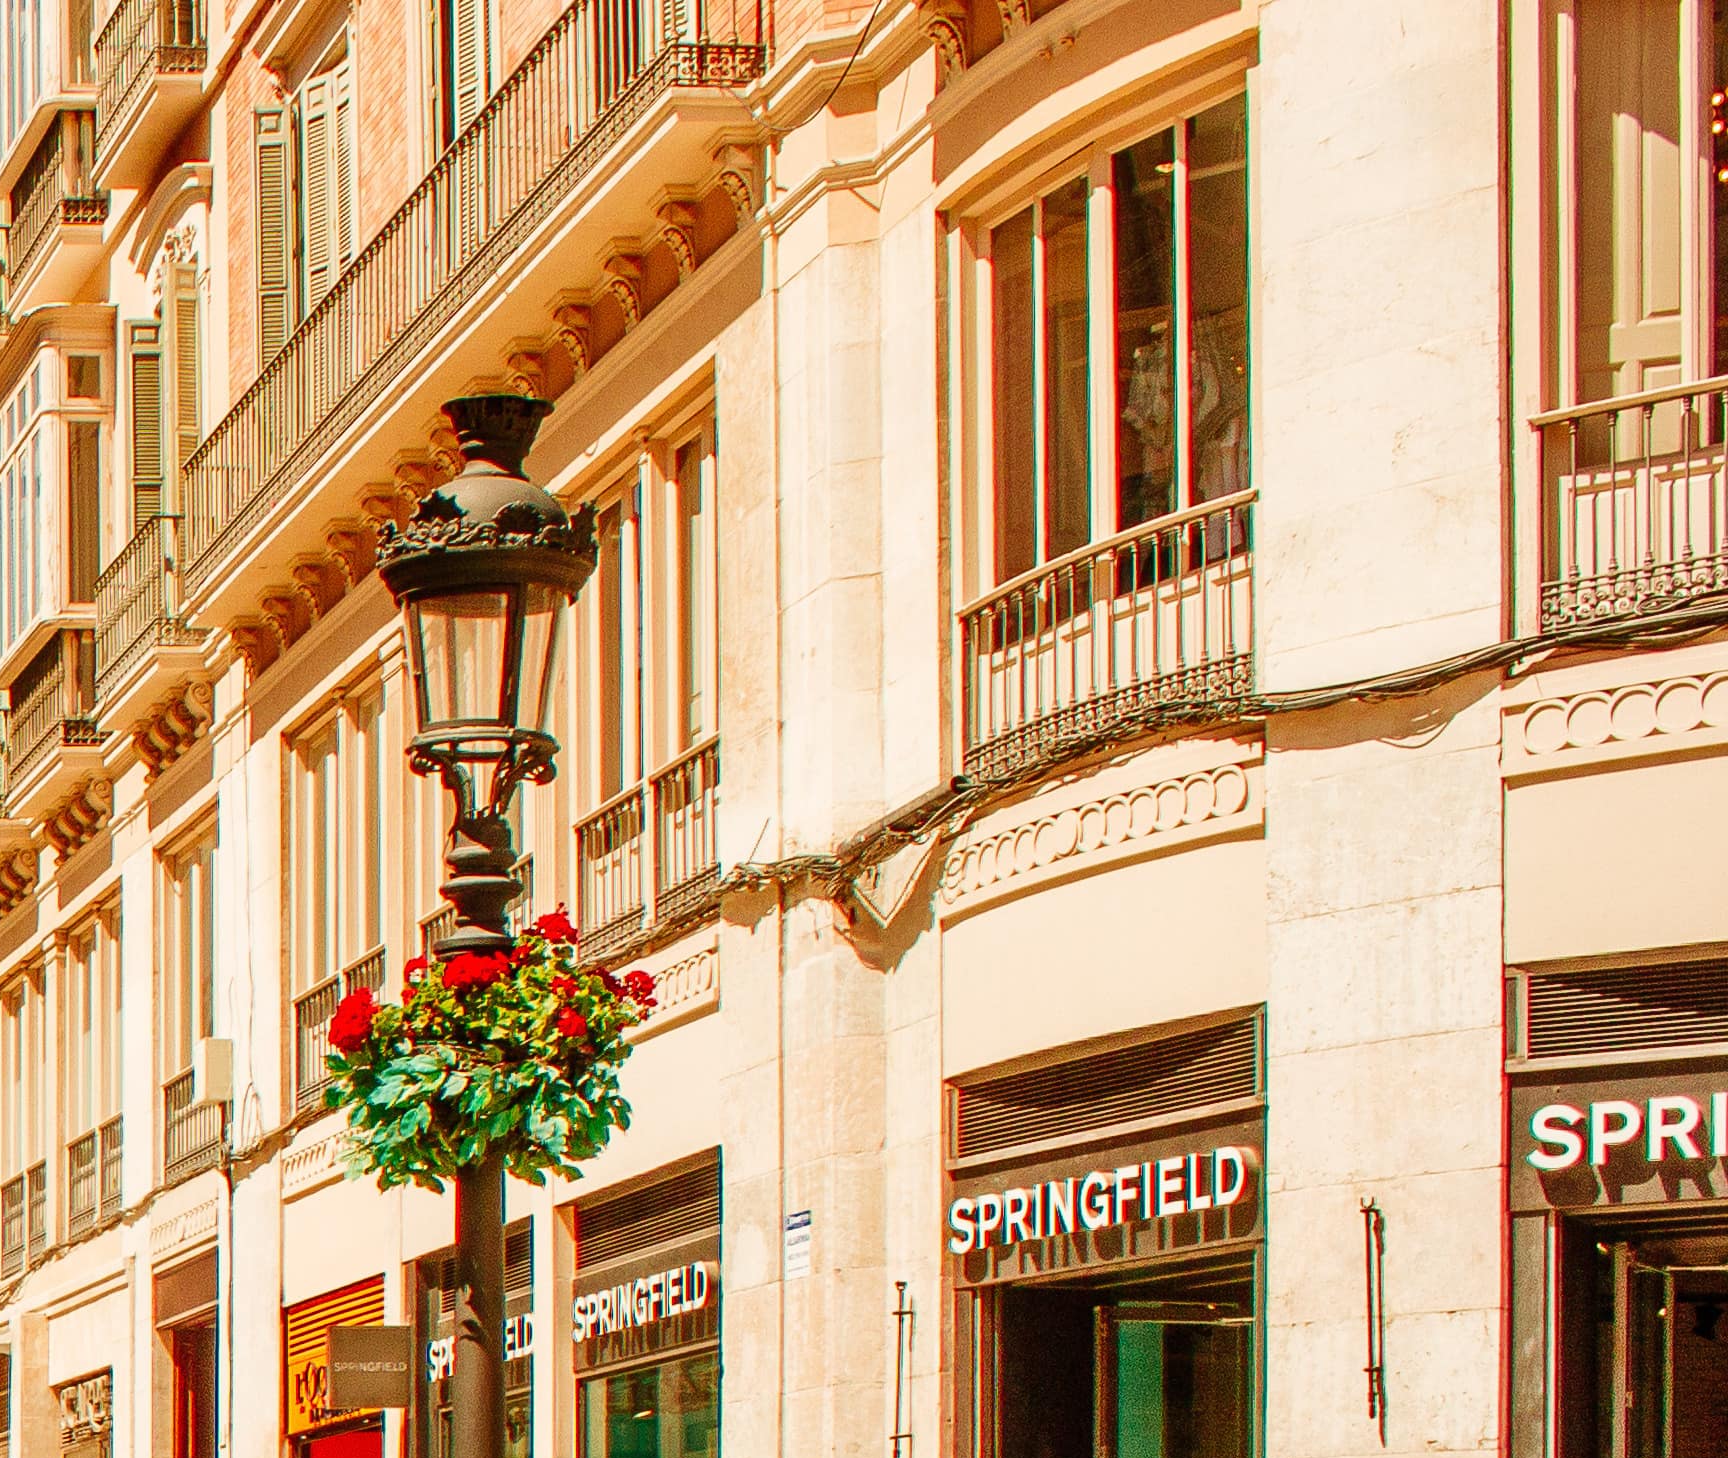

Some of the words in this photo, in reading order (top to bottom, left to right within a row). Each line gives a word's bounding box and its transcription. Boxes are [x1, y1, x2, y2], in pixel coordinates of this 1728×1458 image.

[1526, 1091, 1728, 1172] SPRI
[948, 1146, 1246, 1255] SPRINGFIELD
[572, 1260, 711, 1343] SPRINGFIELD
